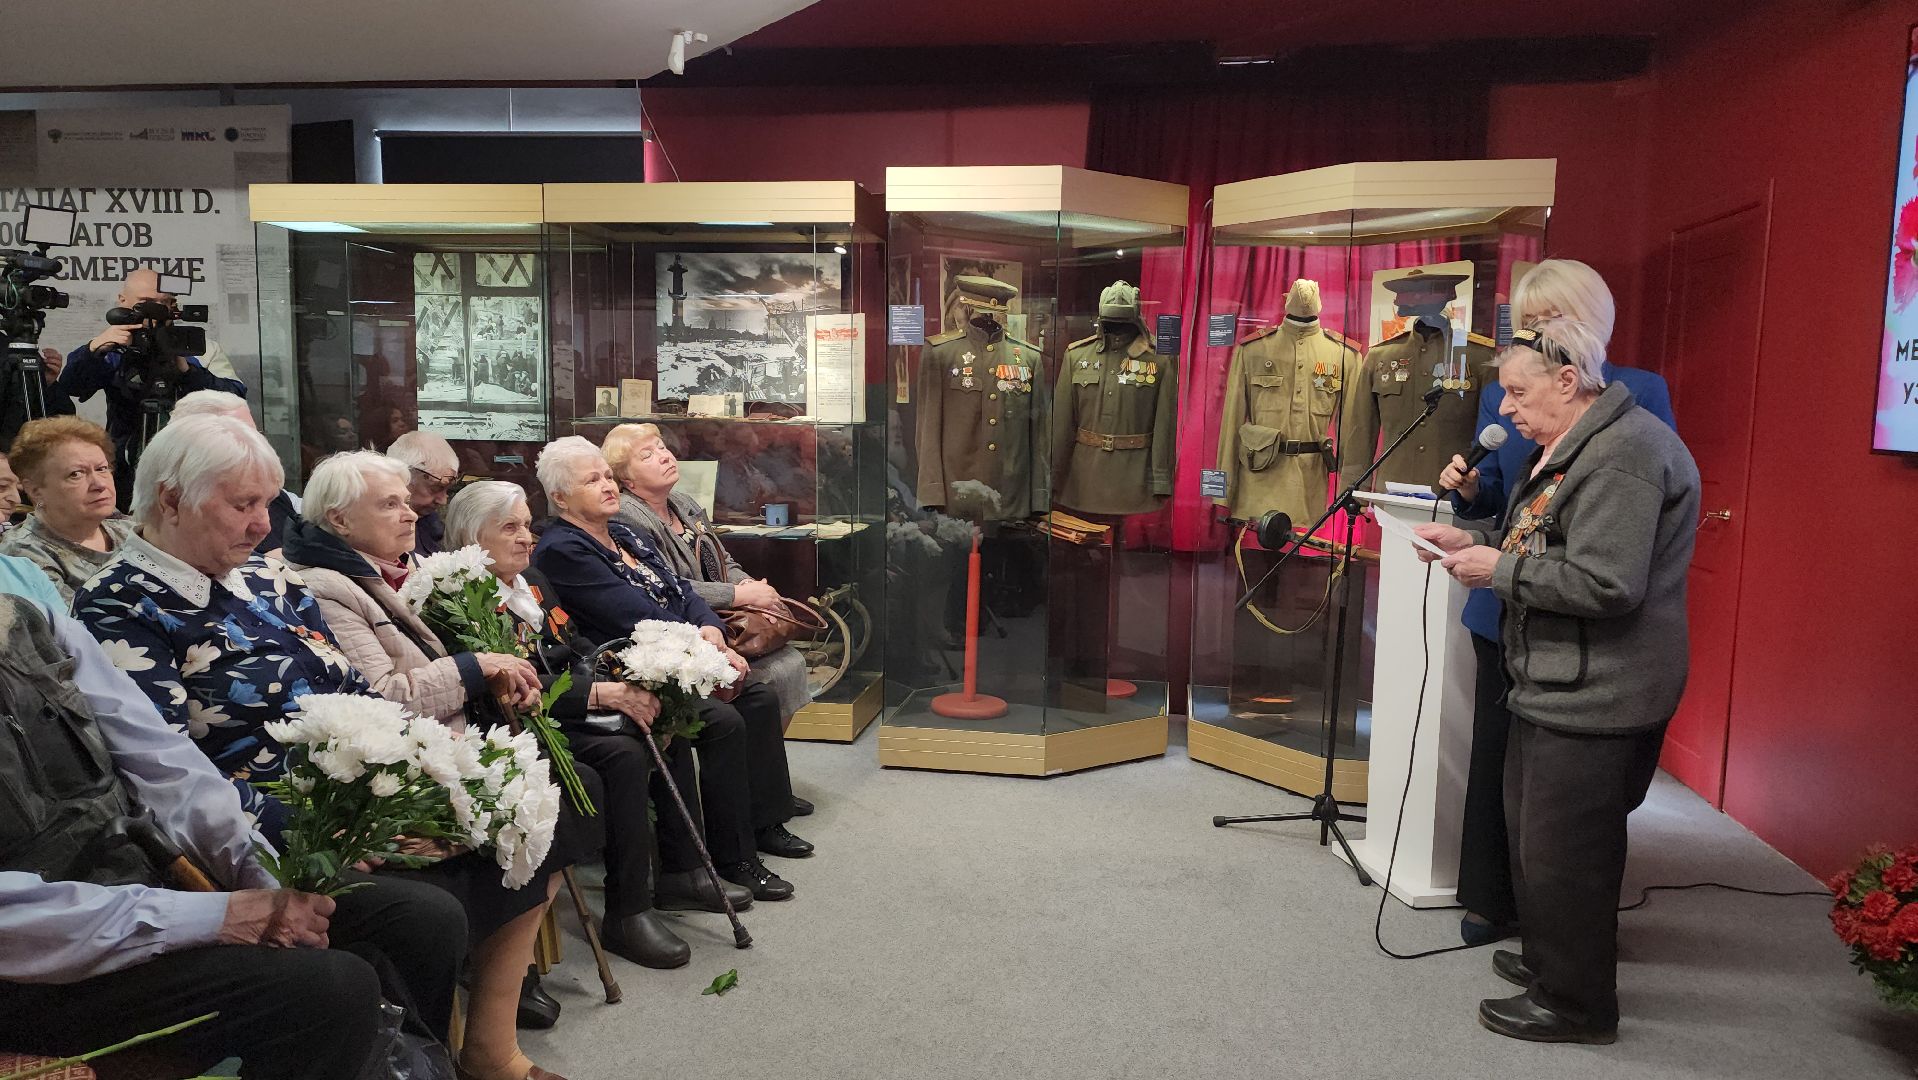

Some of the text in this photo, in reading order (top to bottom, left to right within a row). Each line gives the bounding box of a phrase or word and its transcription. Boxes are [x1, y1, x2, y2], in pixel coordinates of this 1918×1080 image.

[105, 188, 184, 214] XVIII
[192, 188, 221, 214] D.
[72, 223, 153, 248] АГОВ
[40, 256, 206, 283] СМЕРТИЕ
